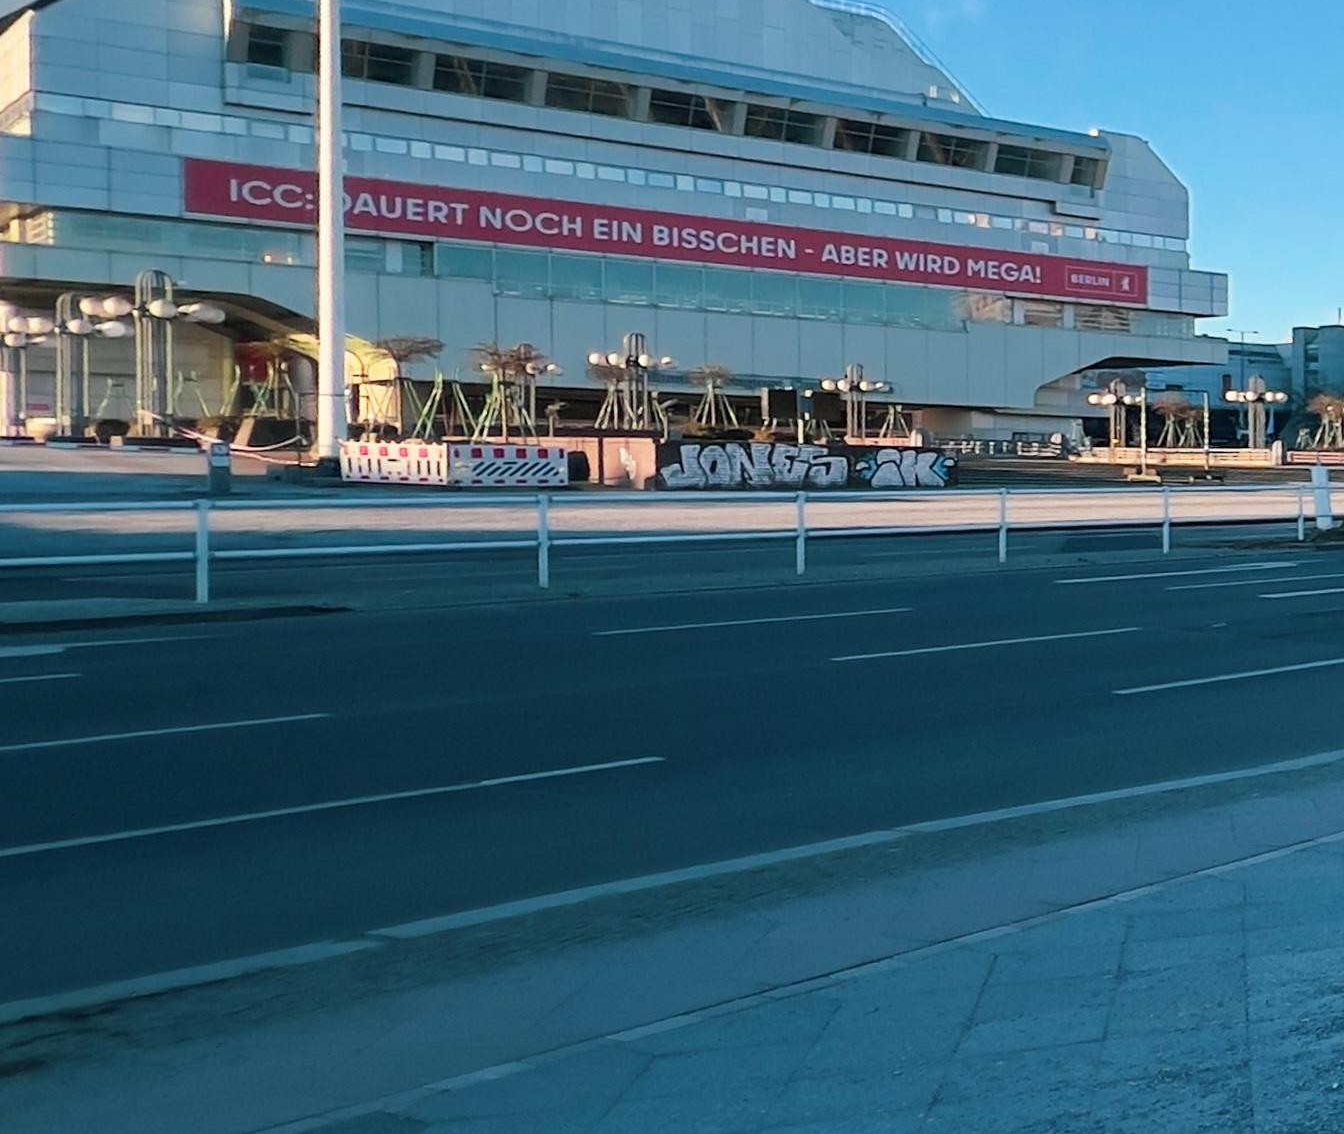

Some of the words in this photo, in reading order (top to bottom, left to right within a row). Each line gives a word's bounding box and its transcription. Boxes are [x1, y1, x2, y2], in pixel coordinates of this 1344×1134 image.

[229, 178, 314, 210] ICC:
[479, 206, 582, 237] NOCH
[593, 219, 642, 244] EIN
[653, 225, 796, 260] BISSCHEN
[821, 242, 888, 268] ABER
[895, 250, 960, 275] WIRD
[966, 260, 1042, 284] MEGA!
[1070, 272, 1111, 288] BERLIN
